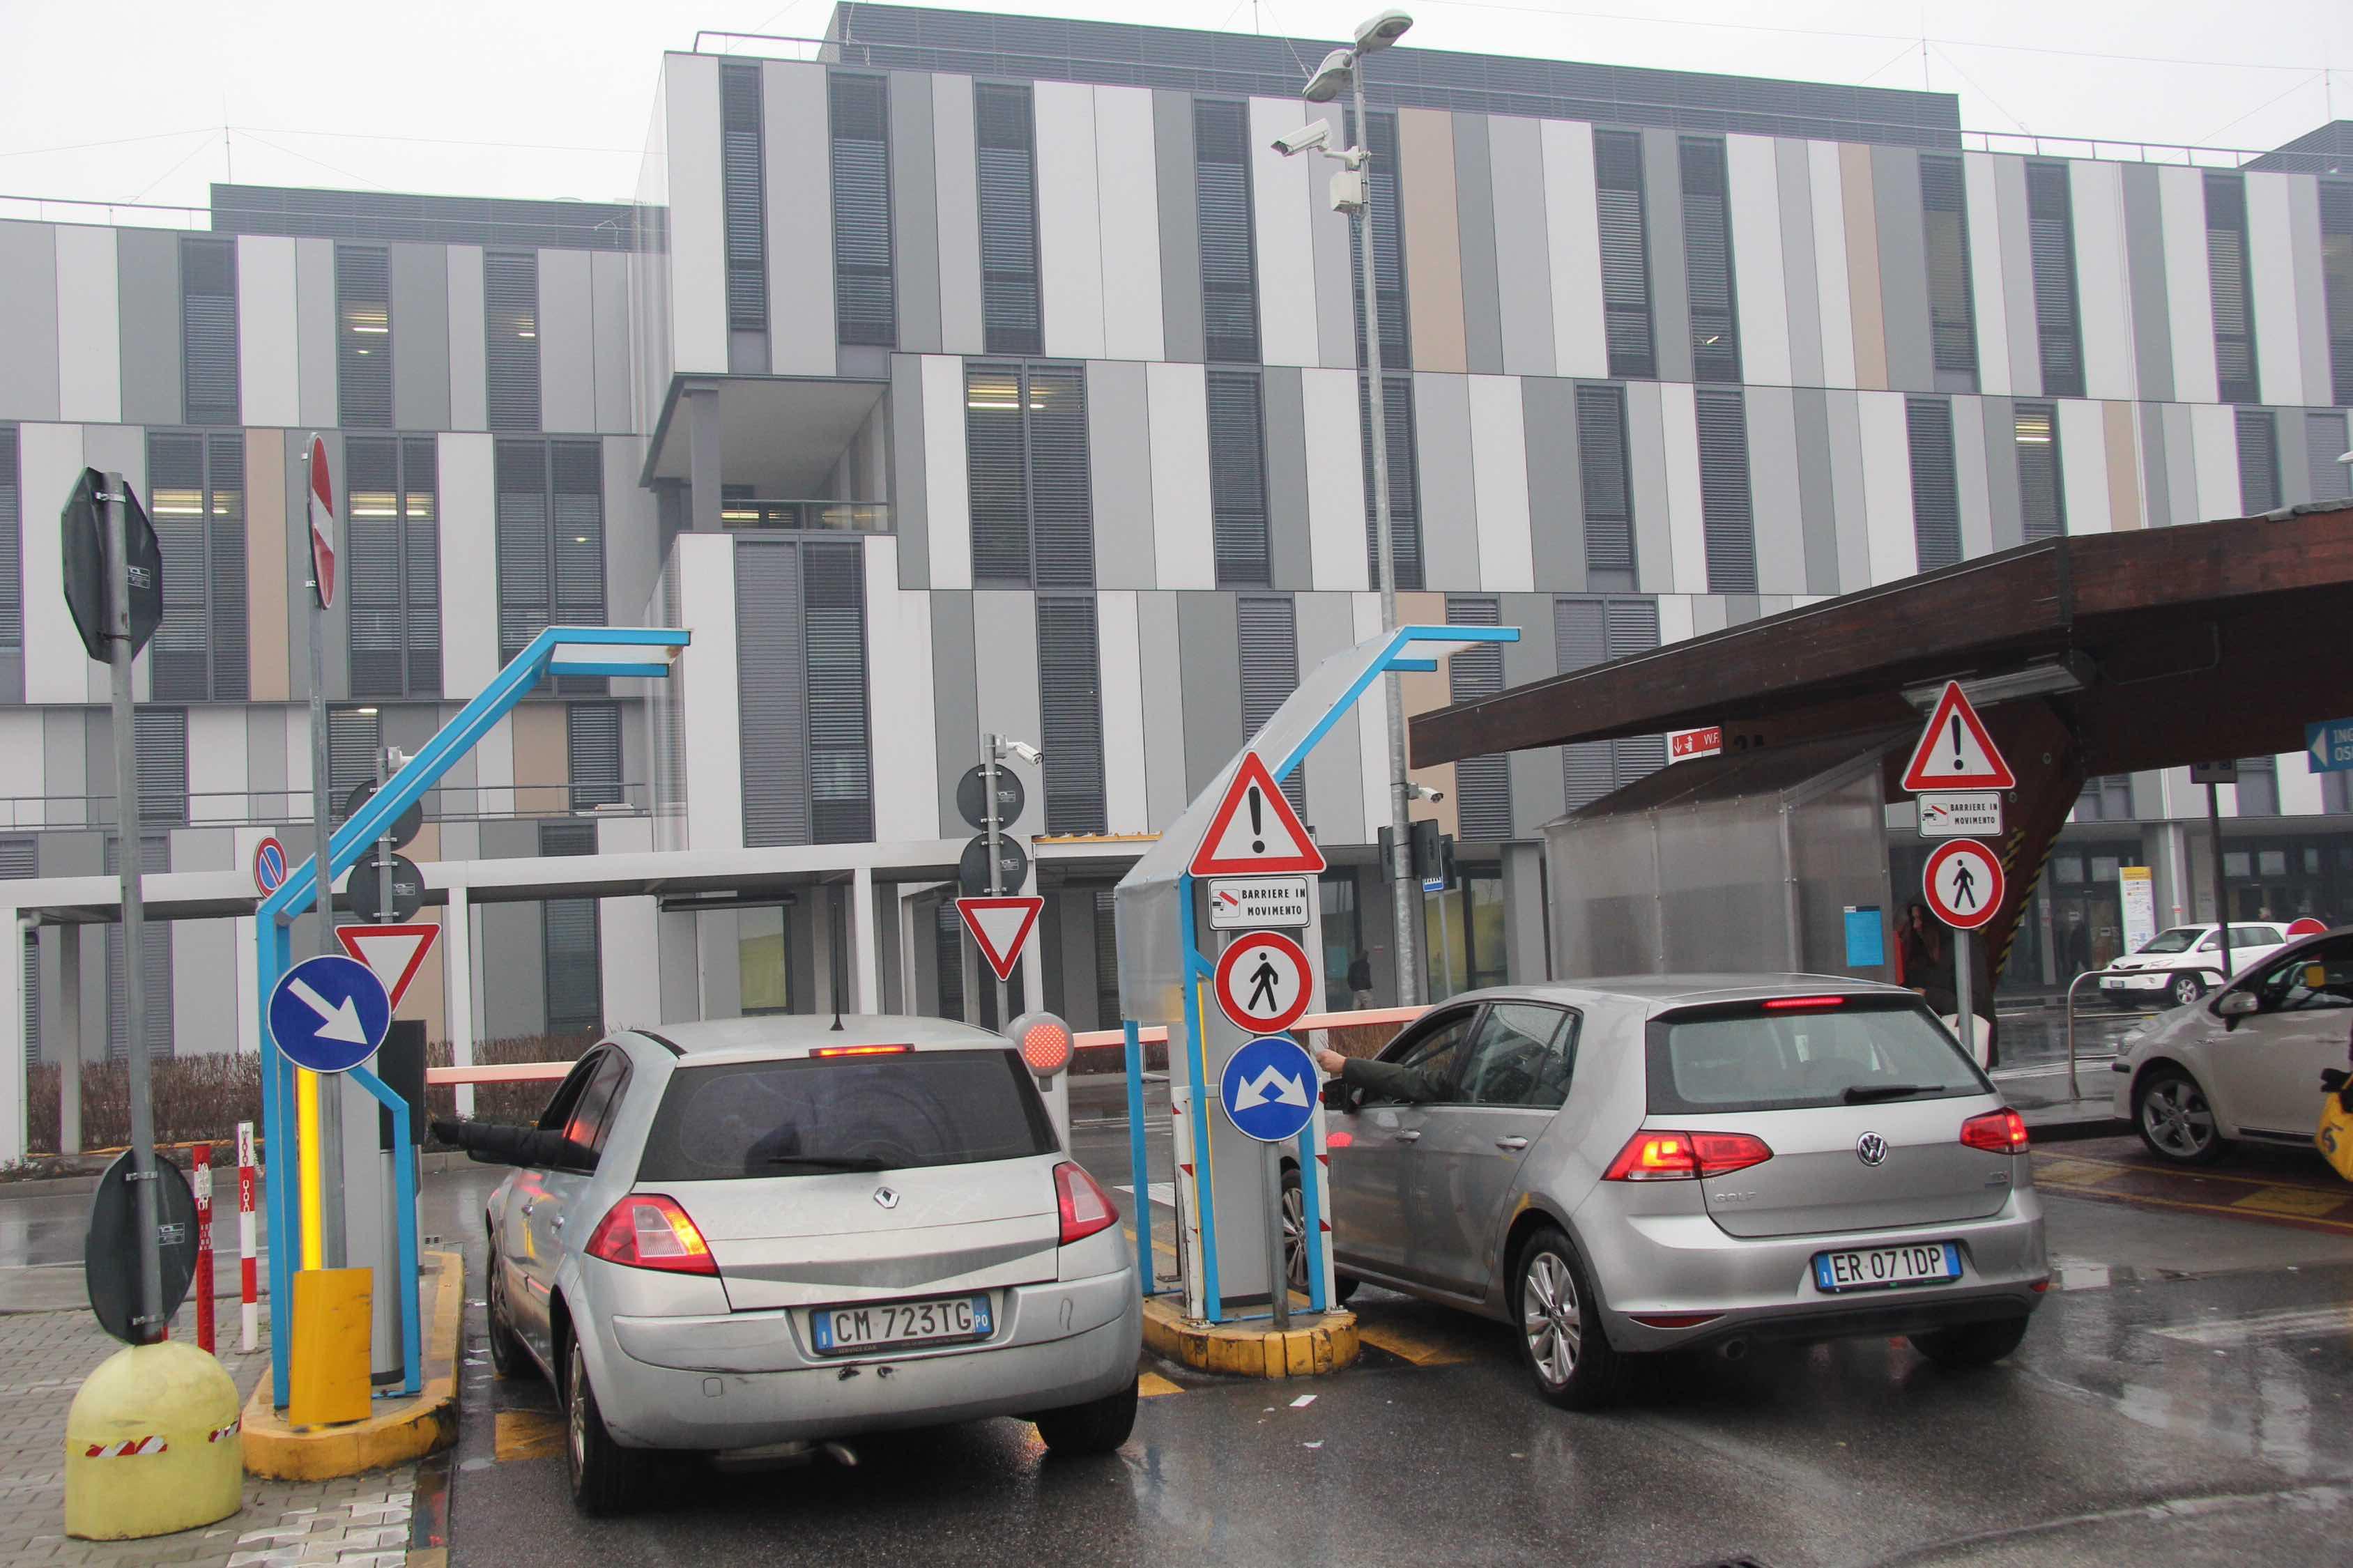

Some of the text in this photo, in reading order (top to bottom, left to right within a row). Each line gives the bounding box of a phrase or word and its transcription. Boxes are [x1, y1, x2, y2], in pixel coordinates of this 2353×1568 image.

[2334, 746, 2353, 761] OS
[1954, 816, 1995, 824] MOVIMENTO
[1242, 889, 1305, 899] BARRIERE IN
[1248, 906, 1302, 916] MOVIMENTO
[1832, 1254, 1863, 1282] ER
[1871, 1247, 1940, 1279] 071DP
[836, 1310, 871, 1342] CM
[882, 1302, 972, 1339] 723TG
[975, 1314, 988, 1328] PO
